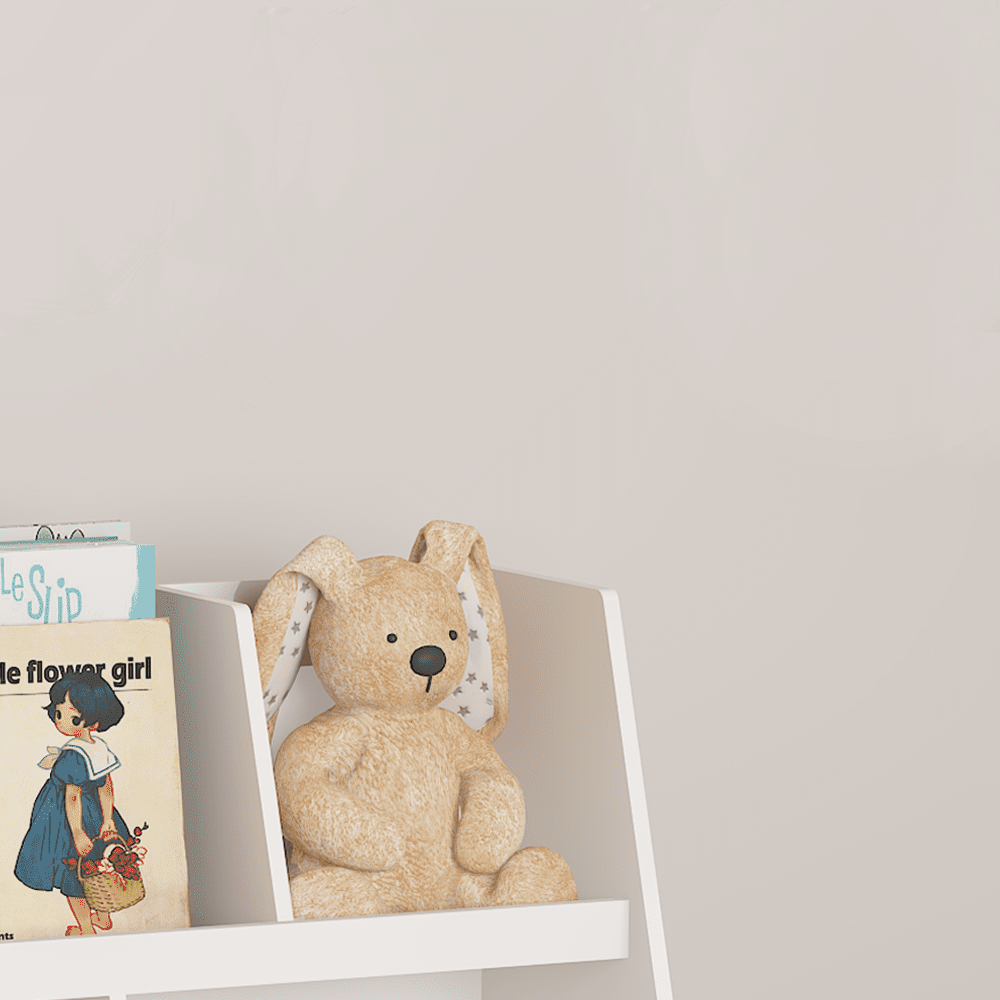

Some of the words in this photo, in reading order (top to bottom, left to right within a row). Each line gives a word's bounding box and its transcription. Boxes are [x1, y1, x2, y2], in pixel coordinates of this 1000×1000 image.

[0, 556, 25, 603] Le
[27, 563, 83, 625] Slip
[111, 655, 152, 688] girl
